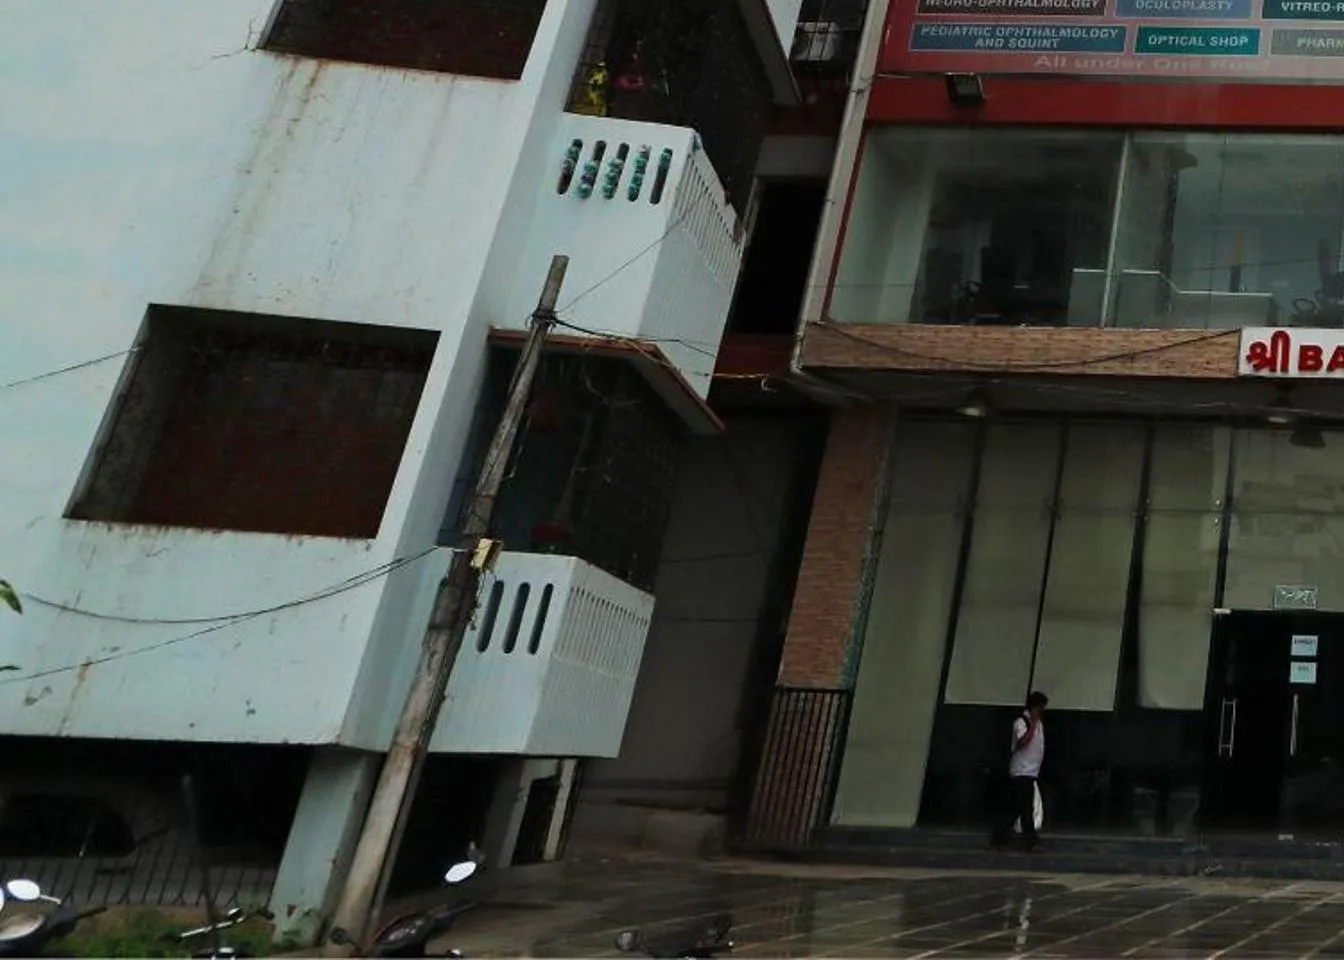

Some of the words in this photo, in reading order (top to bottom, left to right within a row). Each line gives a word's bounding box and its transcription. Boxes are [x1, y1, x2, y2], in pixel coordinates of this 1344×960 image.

[921, 25, 992, 37] PEDIATRIC
[995, 26, 1119, 38] OPHTHALMOLOGY
[975, 38, 1003, 48] AND
[1008, 38, 1061, 49] SQUINT
[1148, 34, 1205, 46] OPTICAL
[1210, 35, 1249, 48] SHOP
[1034, 55, 1066, 68] All
[1074, 56, 1145, 69] under
[1246, 330, 1291, 374] श्री
